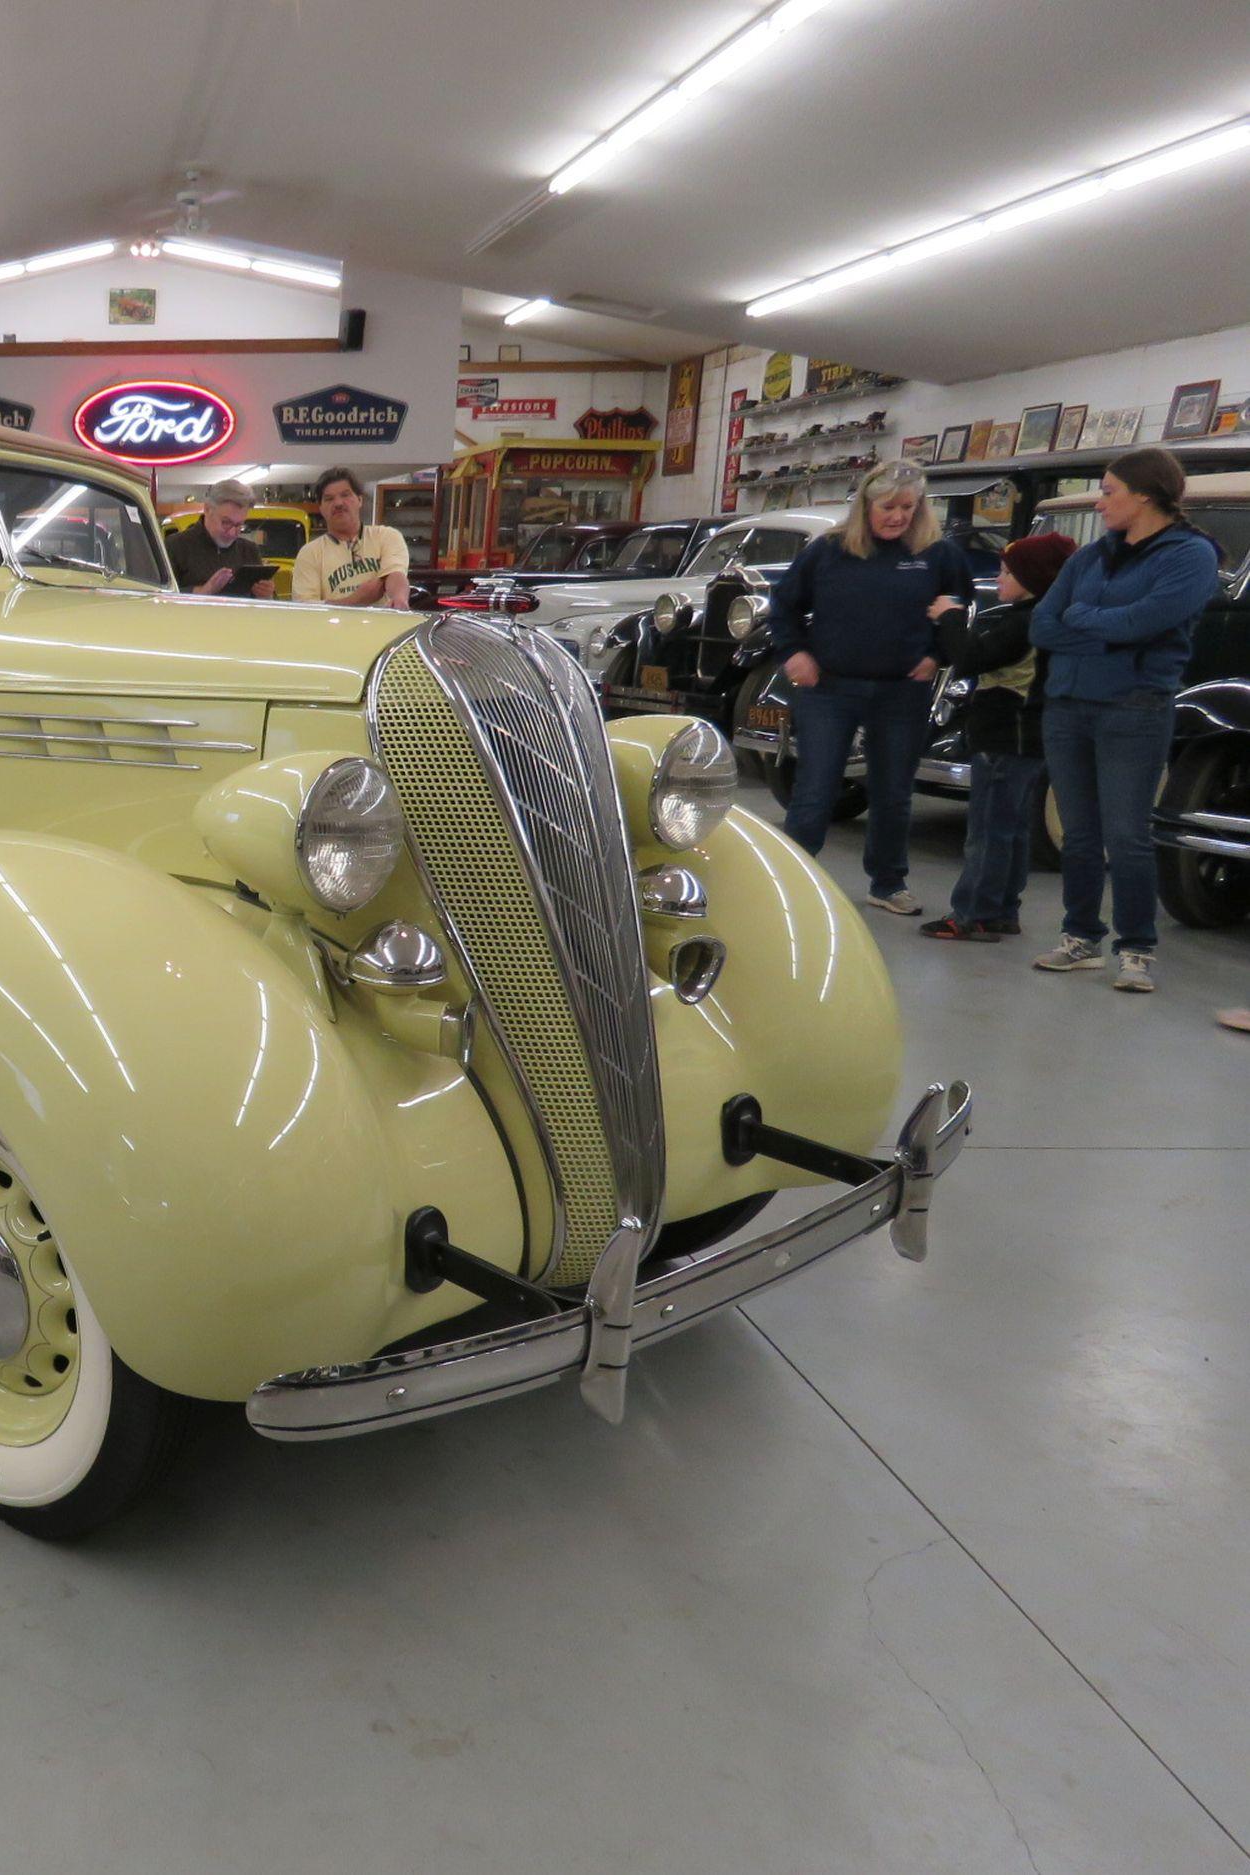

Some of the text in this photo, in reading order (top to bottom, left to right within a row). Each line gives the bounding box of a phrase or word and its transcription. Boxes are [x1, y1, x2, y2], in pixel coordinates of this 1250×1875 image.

[94, 395, 214, 444] Ford
[585, 416, 644, 438] Phillips
[529, 454, 613, 471] POPCORN
